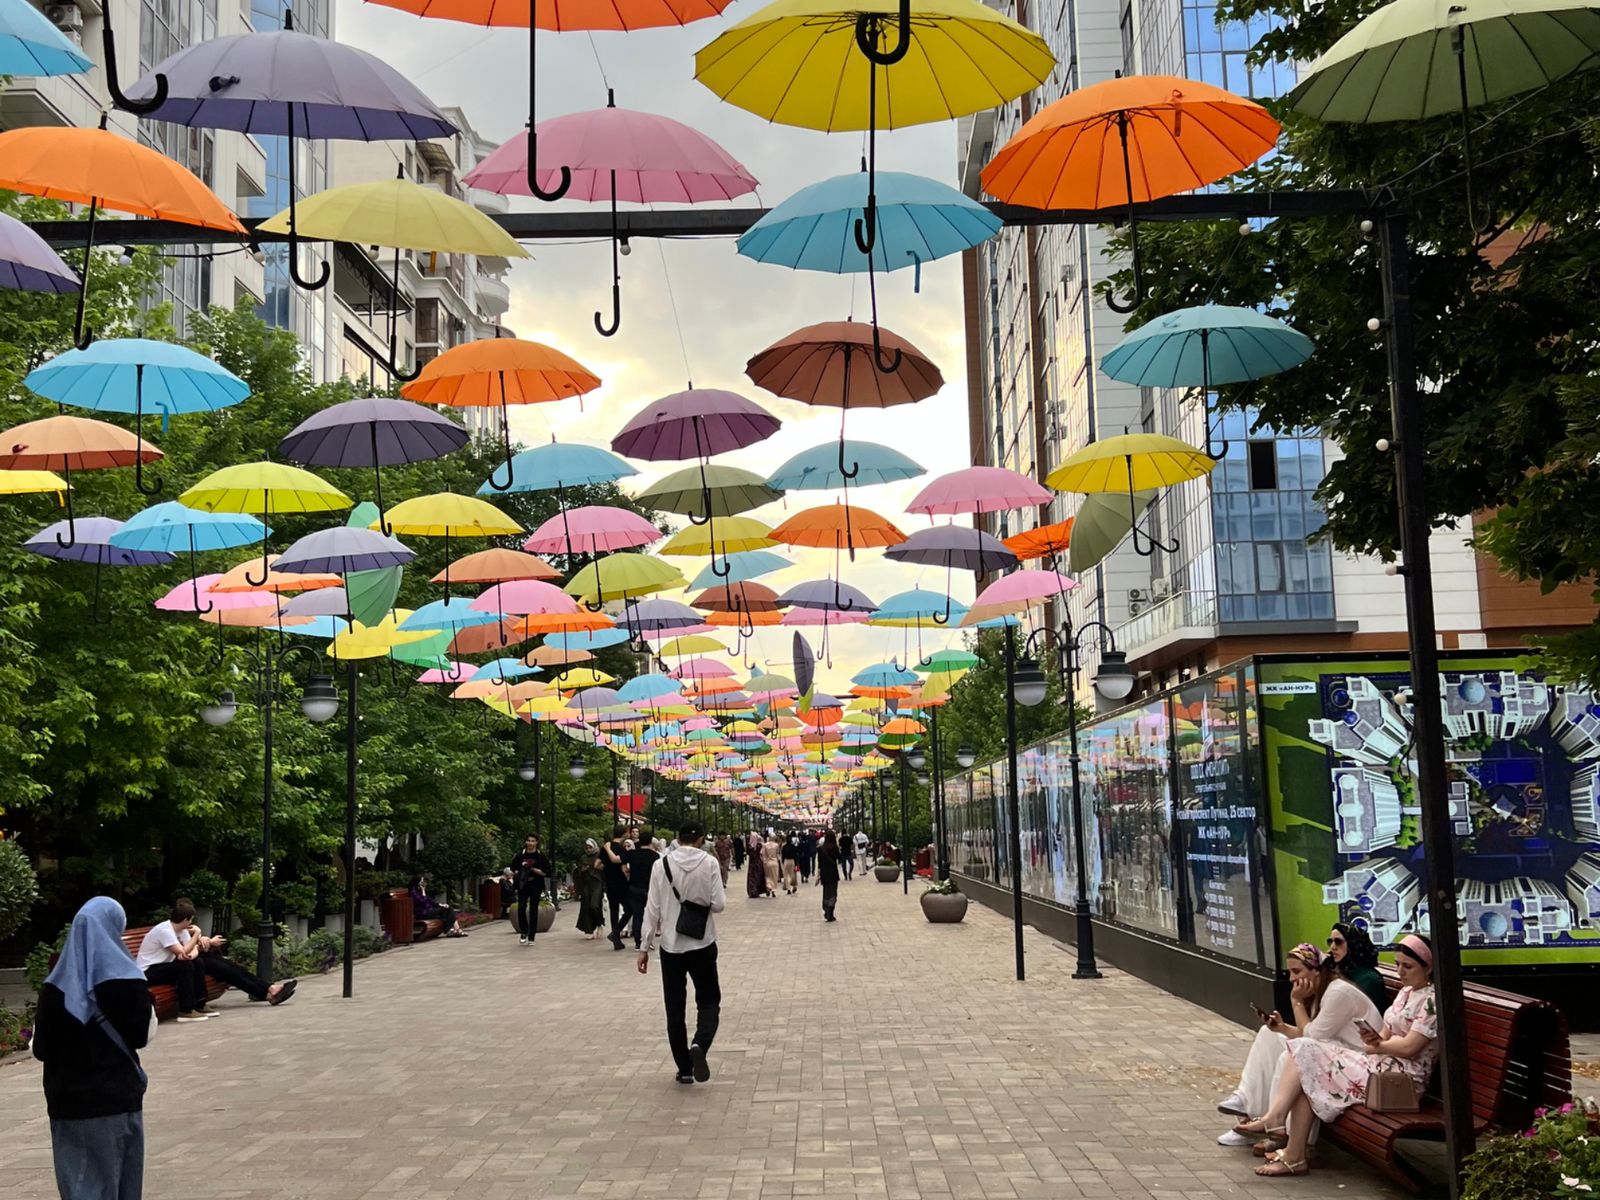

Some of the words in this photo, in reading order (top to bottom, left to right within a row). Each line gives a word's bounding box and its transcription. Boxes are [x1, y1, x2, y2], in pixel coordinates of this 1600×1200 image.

[1230, 804, 1236, 818] 25
[1237, 806, 1256, 821] сектор
[1197, 826, 1206, 839] ЖК
